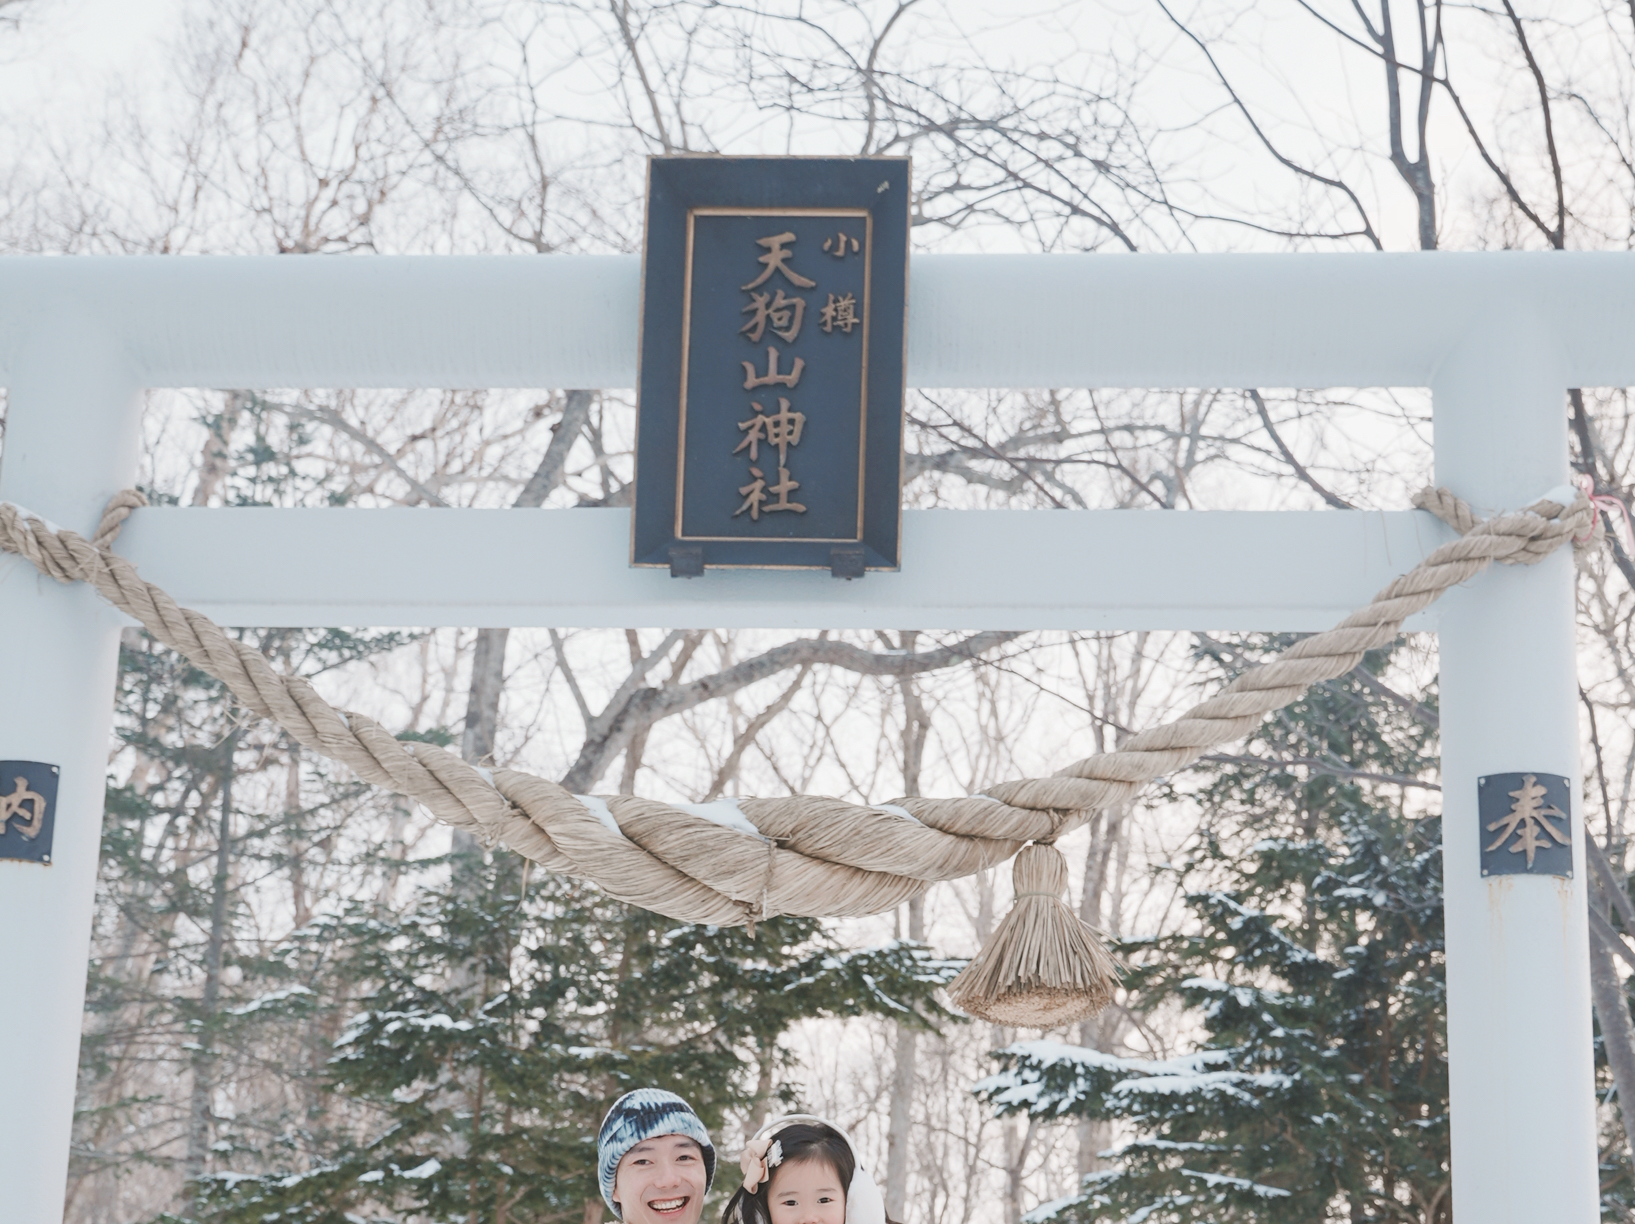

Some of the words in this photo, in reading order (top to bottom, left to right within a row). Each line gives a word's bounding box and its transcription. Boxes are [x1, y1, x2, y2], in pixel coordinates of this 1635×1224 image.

[819, 231, 860, 333] 小樽
[732, 231, 816, 520] 天狗山神社
[1486, 774, 1571, 870] 奉
